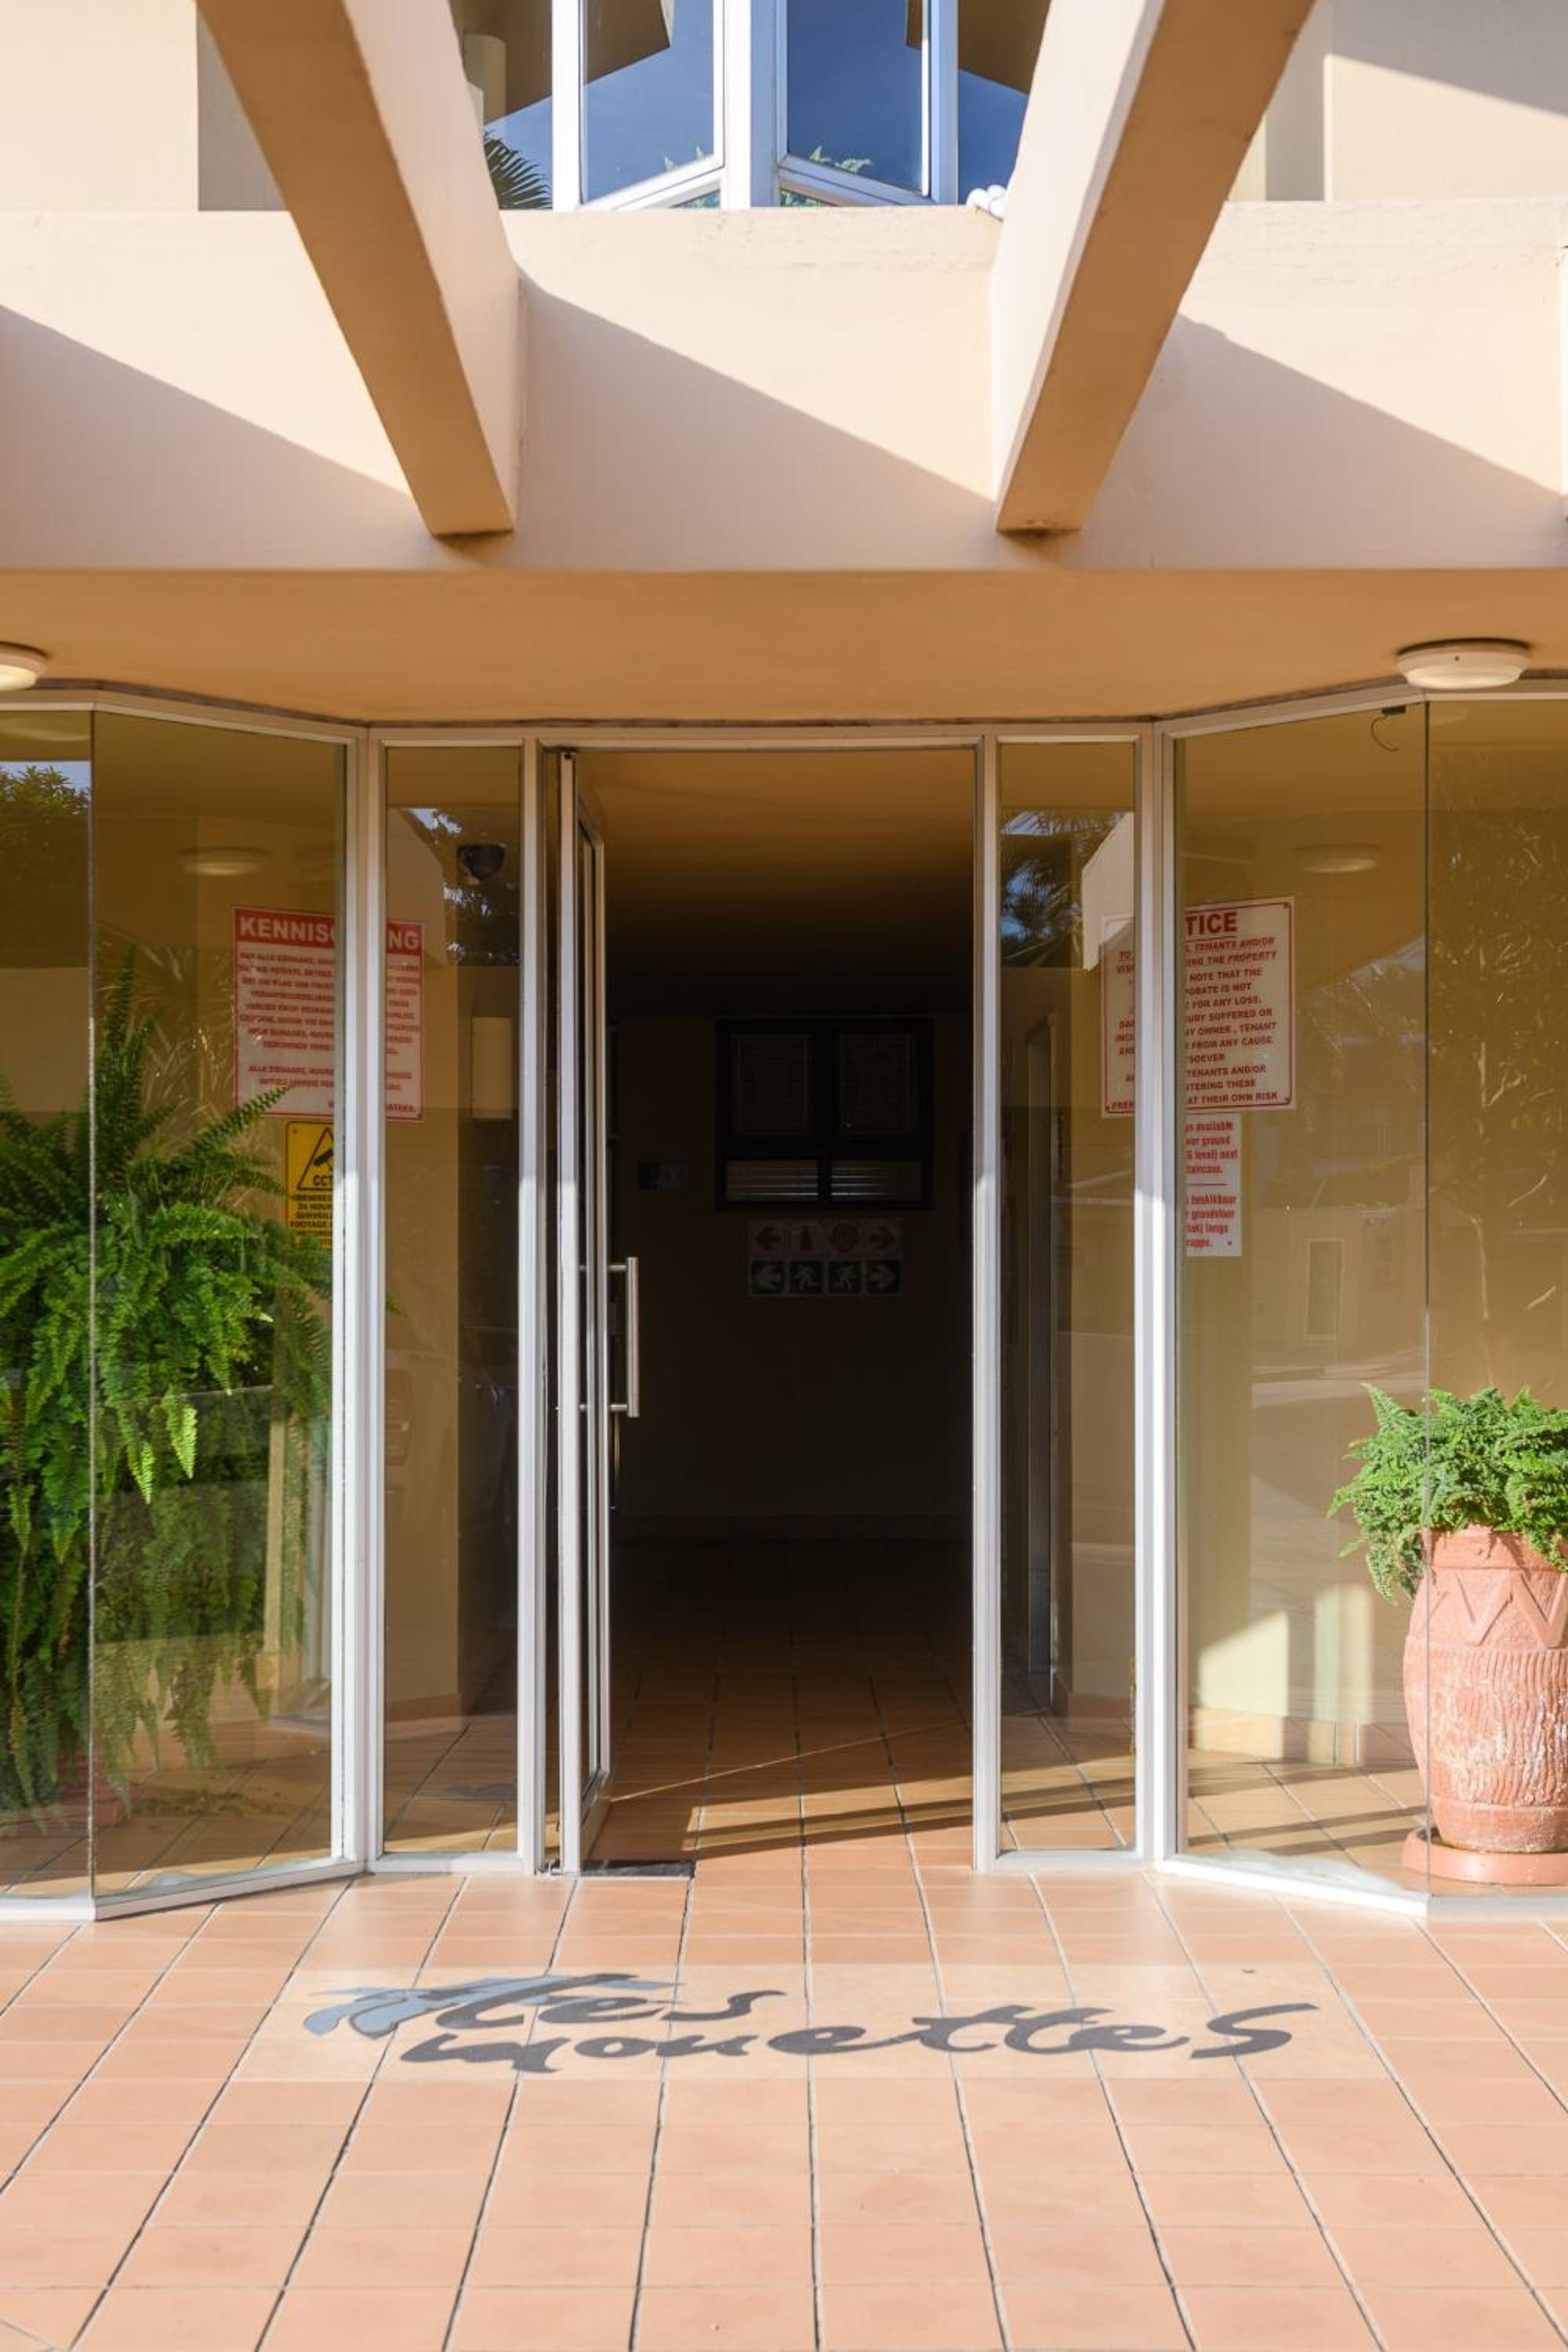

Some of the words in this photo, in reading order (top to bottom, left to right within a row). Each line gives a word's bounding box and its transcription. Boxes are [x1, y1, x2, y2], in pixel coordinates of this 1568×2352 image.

[1185, 912, 1237, 937] TICE
[1226, 949, 1276, 965] PROPERTY
[1189, 972, 1214, 982] NOTE
[1218, 970, 1240, 980] THAT
[1244, 967, 1263, 977] THE
[1221, 984, 1230, 993] IS
[1232, 982, 1252, 992] NOT
[1192, 1000, 1211, 1009] FOR
[1214, 997, 1232, 1007] ANY
[1208, 1010, 1256, 1022] SUFFERED
[1258, 1008, 1272, 1018] OR
[1197, 1025, 1231, 1035] OWNER
[1240, 1022, 1277, 1033] TENANT
[1219, 1039, 1239, 1048] ANY
[1201, 1094, 1229, 1104] THEIR
[1255, 1091, 1278, 1101] RISK
[1196, 1120, 1233, 1132] available
[1202, 1134, 1230, 1147] ground
[314, 1174, 333, 1186] CCT
